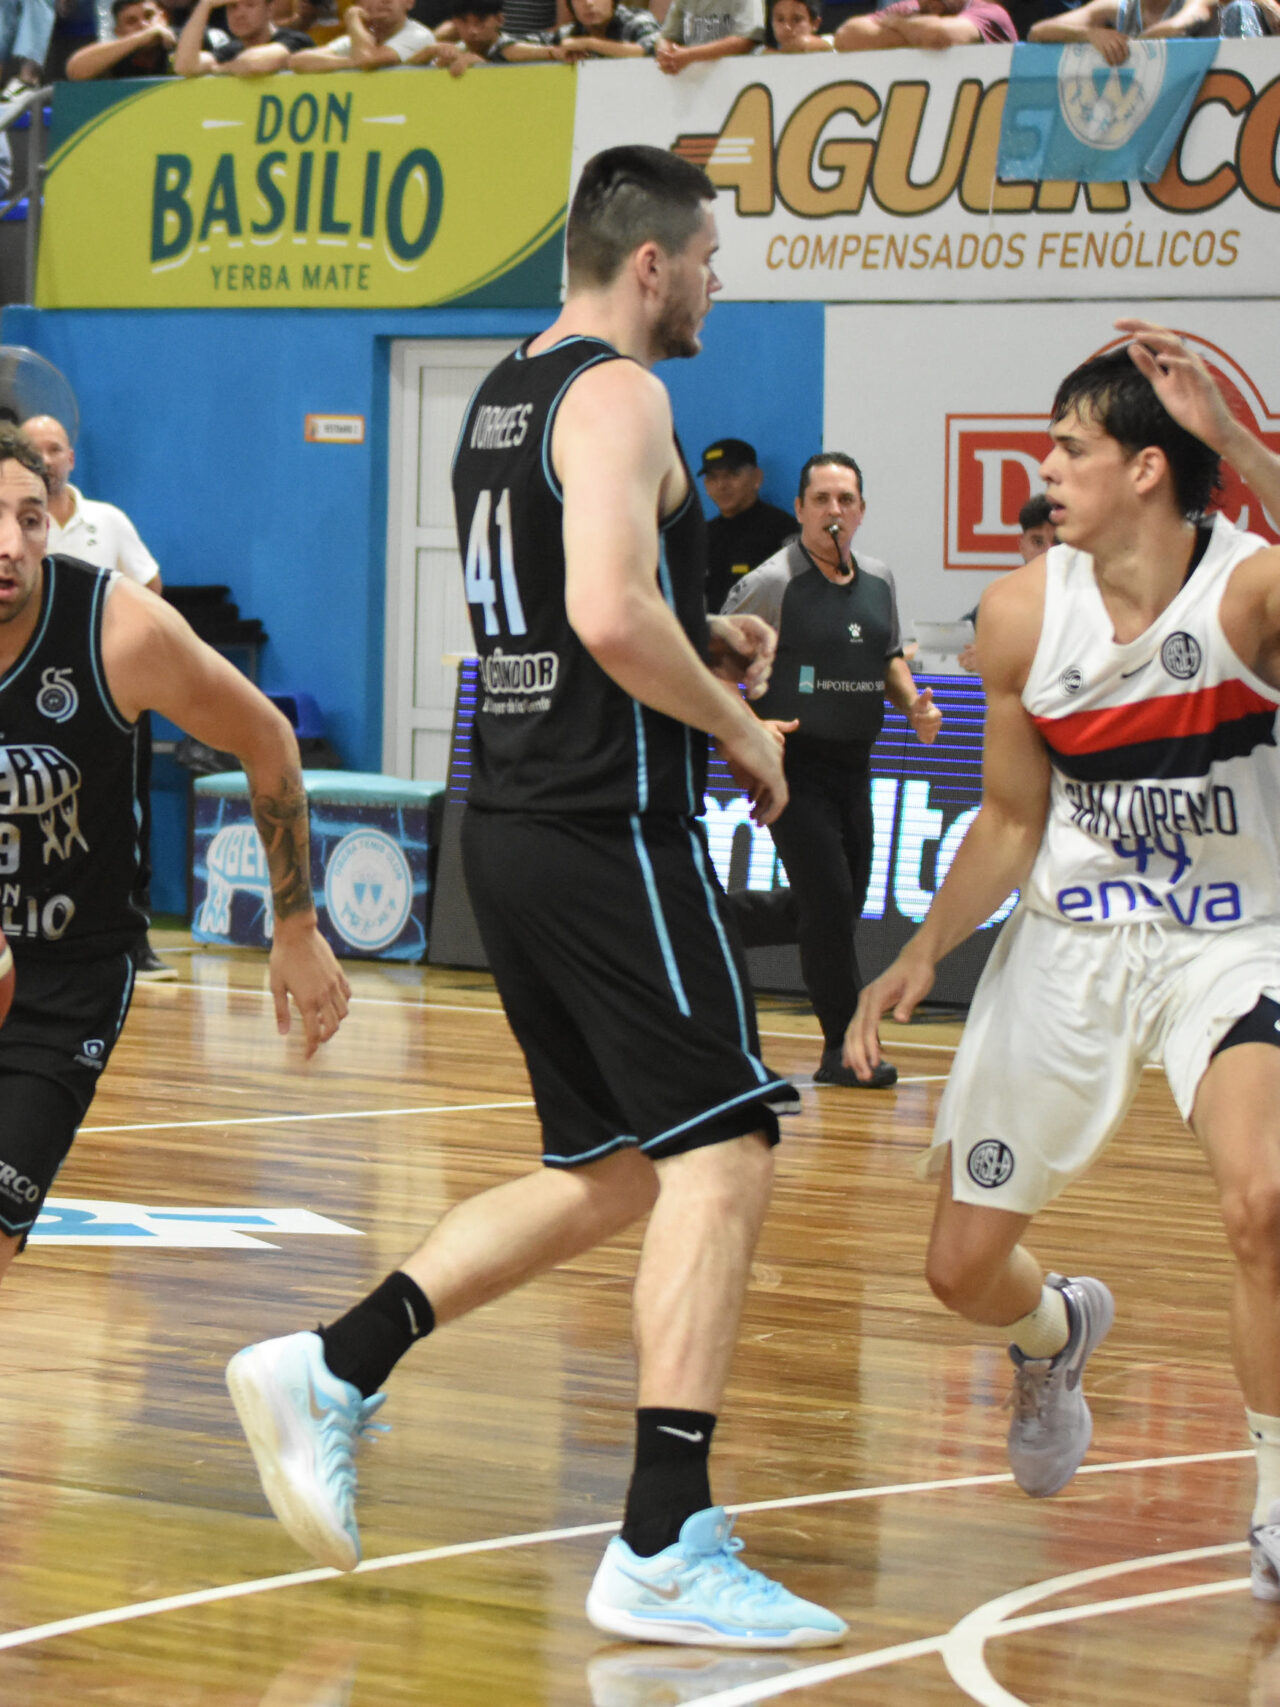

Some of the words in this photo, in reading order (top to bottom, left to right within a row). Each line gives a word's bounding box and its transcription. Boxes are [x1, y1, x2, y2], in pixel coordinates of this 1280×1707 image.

[255, 92, 352, 145] DON
[150, 147, 445, 264] BASILIO
[765, 233, 1027, 270] COMPENSADOS
[1037, 220, 1240, 268] FENÓLICOS
[211, 264, 291, 291] YERBA
[302, 263, 370, 290] MATE
[464, 487, 528, 637] 41
[816, 679, 874, 693] HIPOTECARIO
[1114, 784, 1238, 838] LORENO
